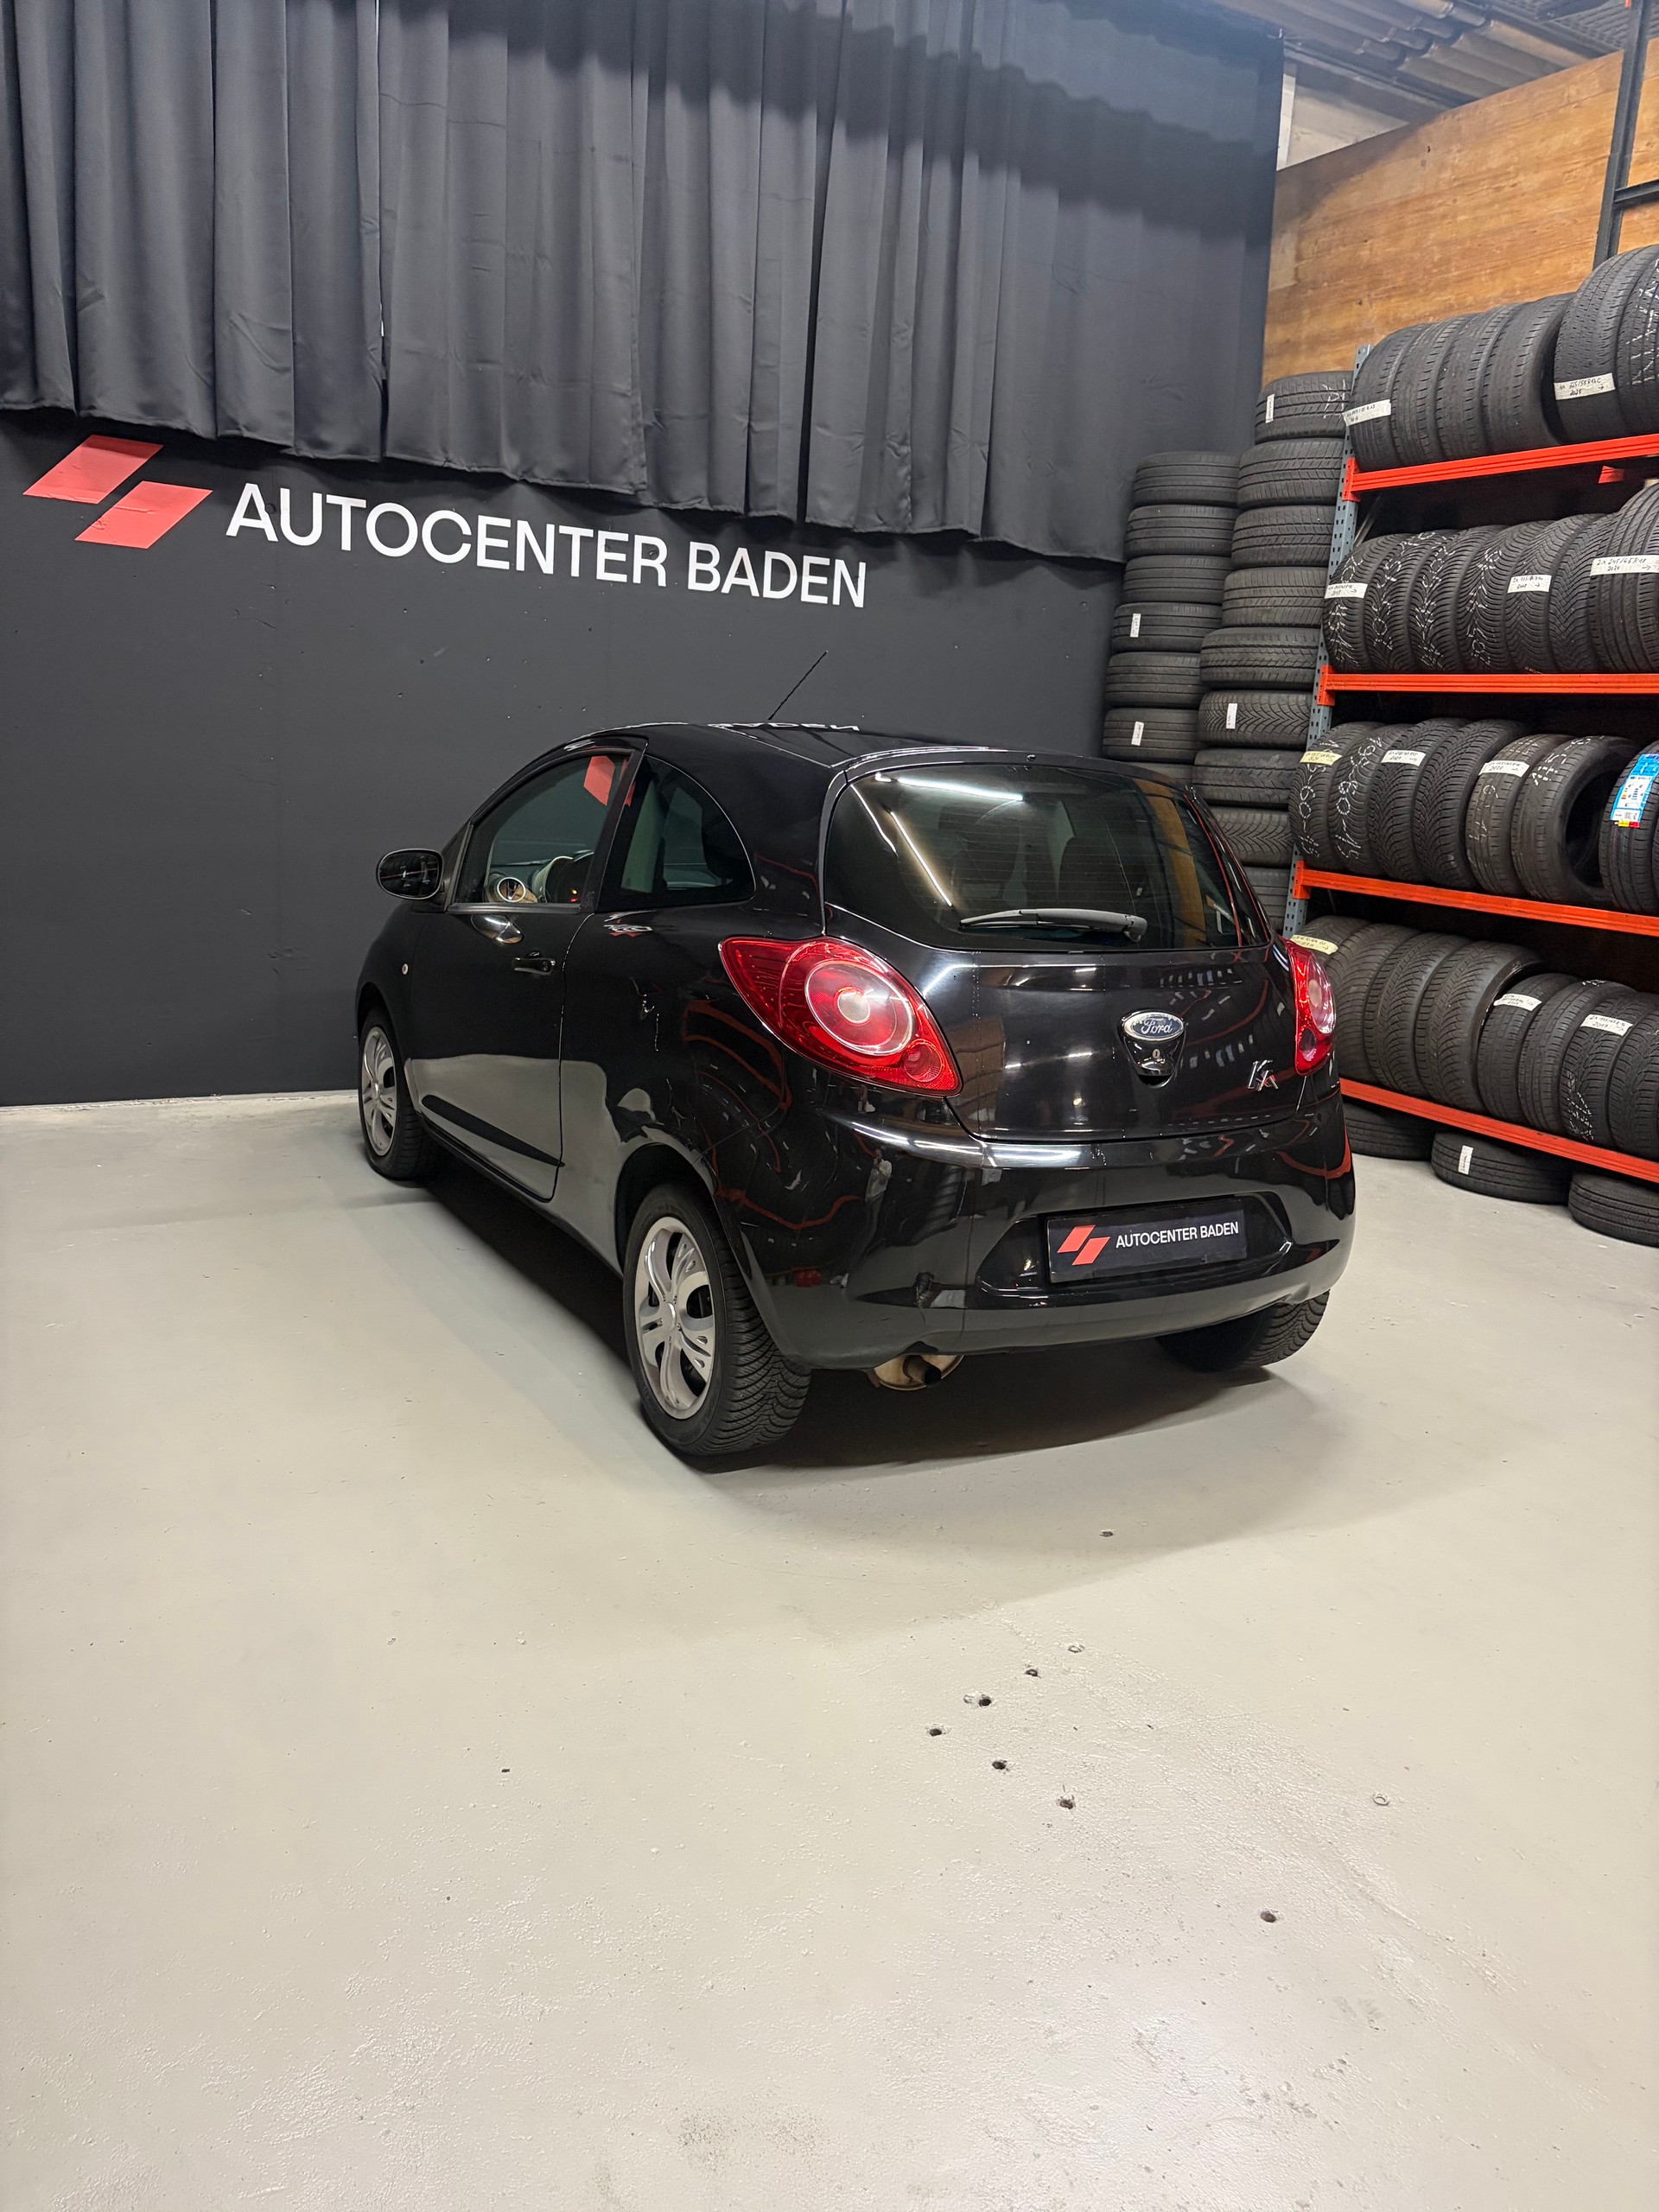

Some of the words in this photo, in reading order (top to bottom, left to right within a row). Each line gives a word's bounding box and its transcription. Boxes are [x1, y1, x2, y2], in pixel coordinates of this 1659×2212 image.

[226, 481, 668, 588] AUTOCENTER
[686, 541, 868, 609] BADEN
[1141, 1018, 1173, 1034] Ford
[1116, 1226, 1198, 1248] AUTOCENTER
[1199, 1220, 1239, 1238] BADEN
